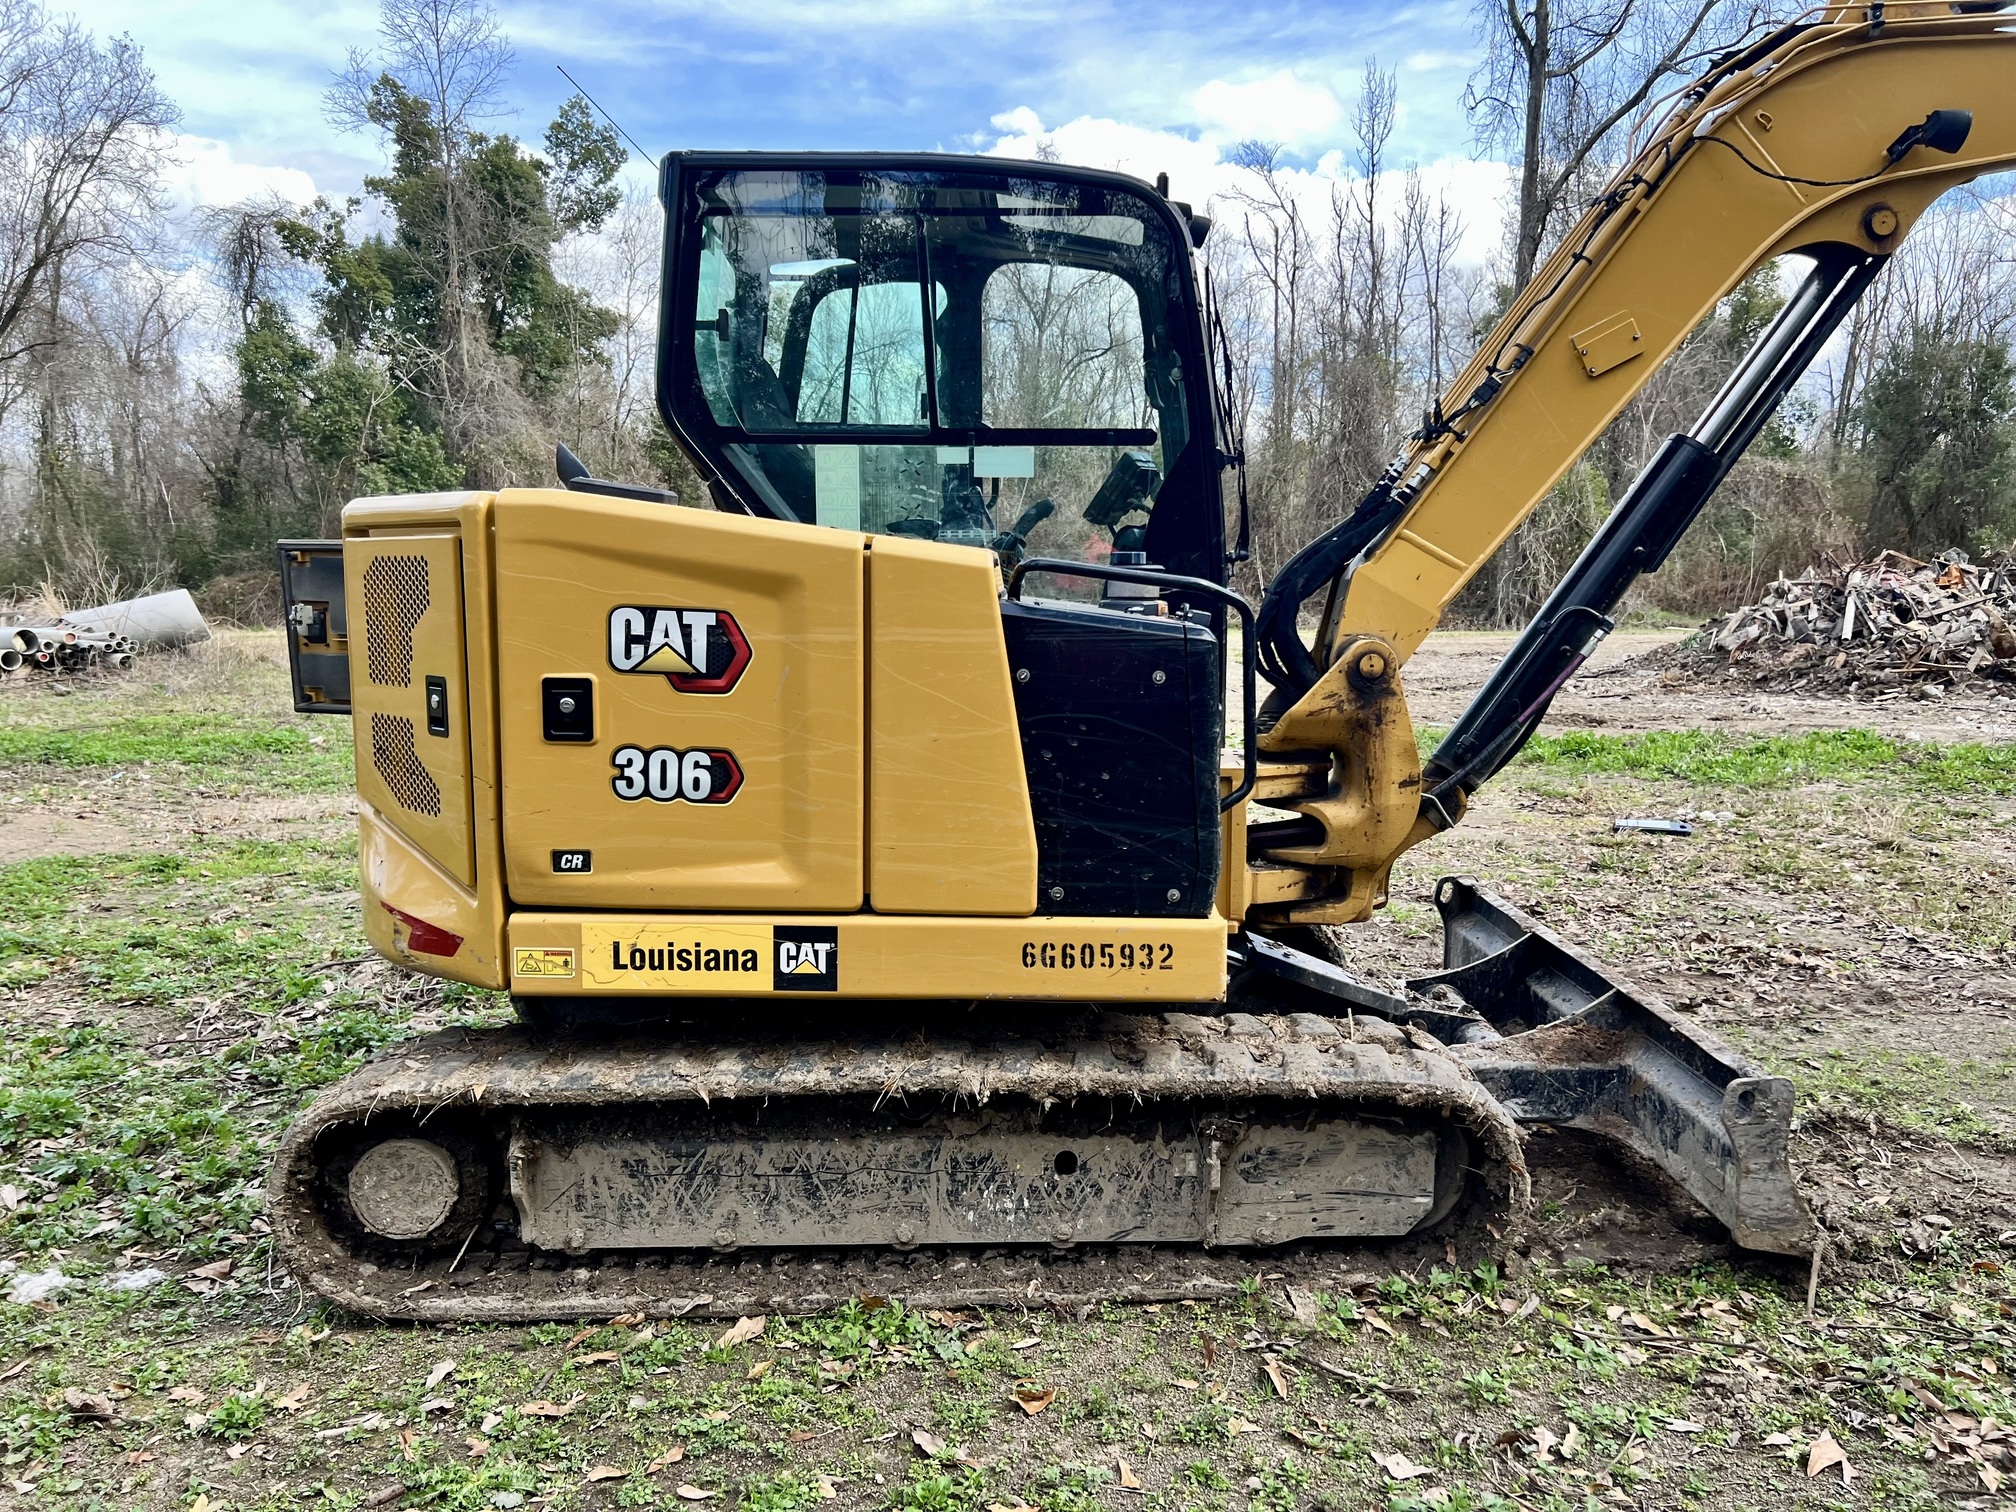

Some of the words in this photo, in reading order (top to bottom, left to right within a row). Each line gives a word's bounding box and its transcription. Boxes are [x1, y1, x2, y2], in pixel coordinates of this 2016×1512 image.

[610, 607, 716, 674] CAT
[614, 748, 712, 800] 306
[560, 854, 583, 869] CR
[614, 941, 758, 972] Louisiana
[779, 942, 831, 975] CAT
[1022, 942, 1174, 970] 6G605932
